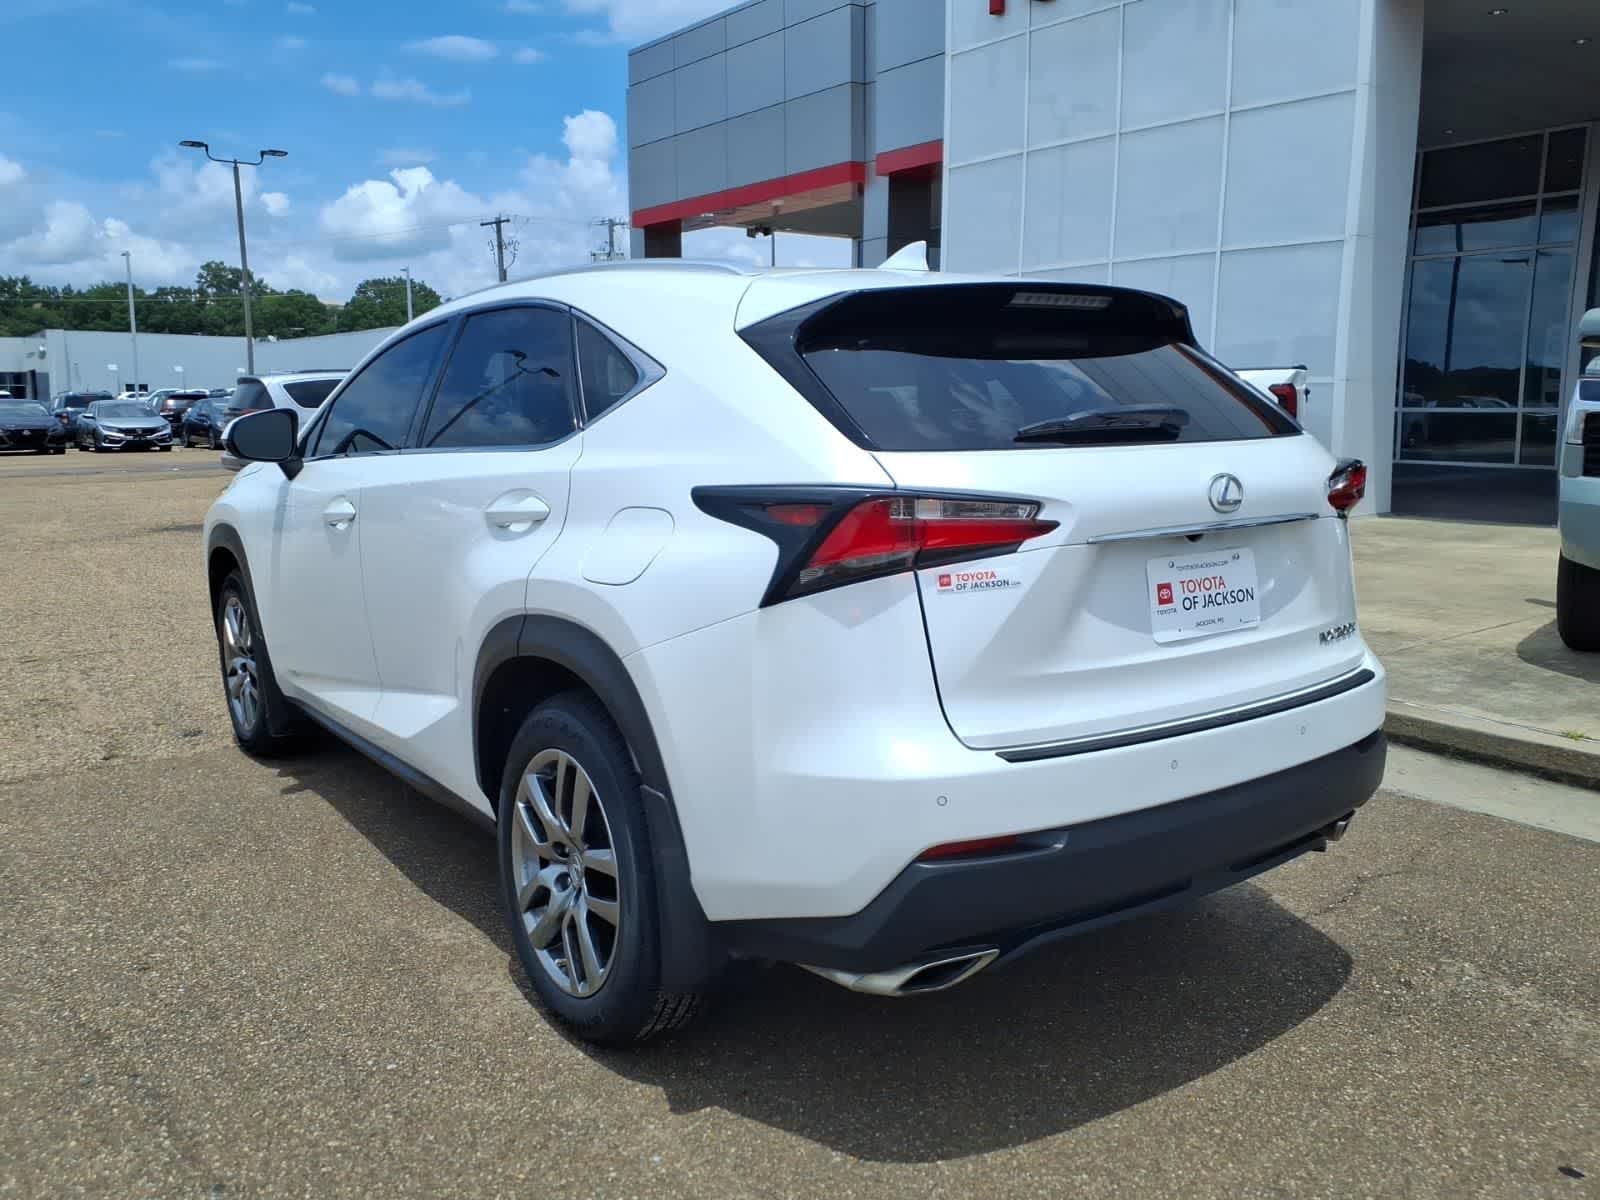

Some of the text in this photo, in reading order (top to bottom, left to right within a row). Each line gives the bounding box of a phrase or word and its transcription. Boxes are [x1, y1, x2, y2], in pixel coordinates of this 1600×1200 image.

[956, 571, 997, 582] TOYOTA
[956, 583, 968, 591] OF
[1179, 576, 1227, 594] TOYOTA
[1182, 587, 1255, 611] OF JACKSON
[1156, 607, 1177, 616] TOYOTA
